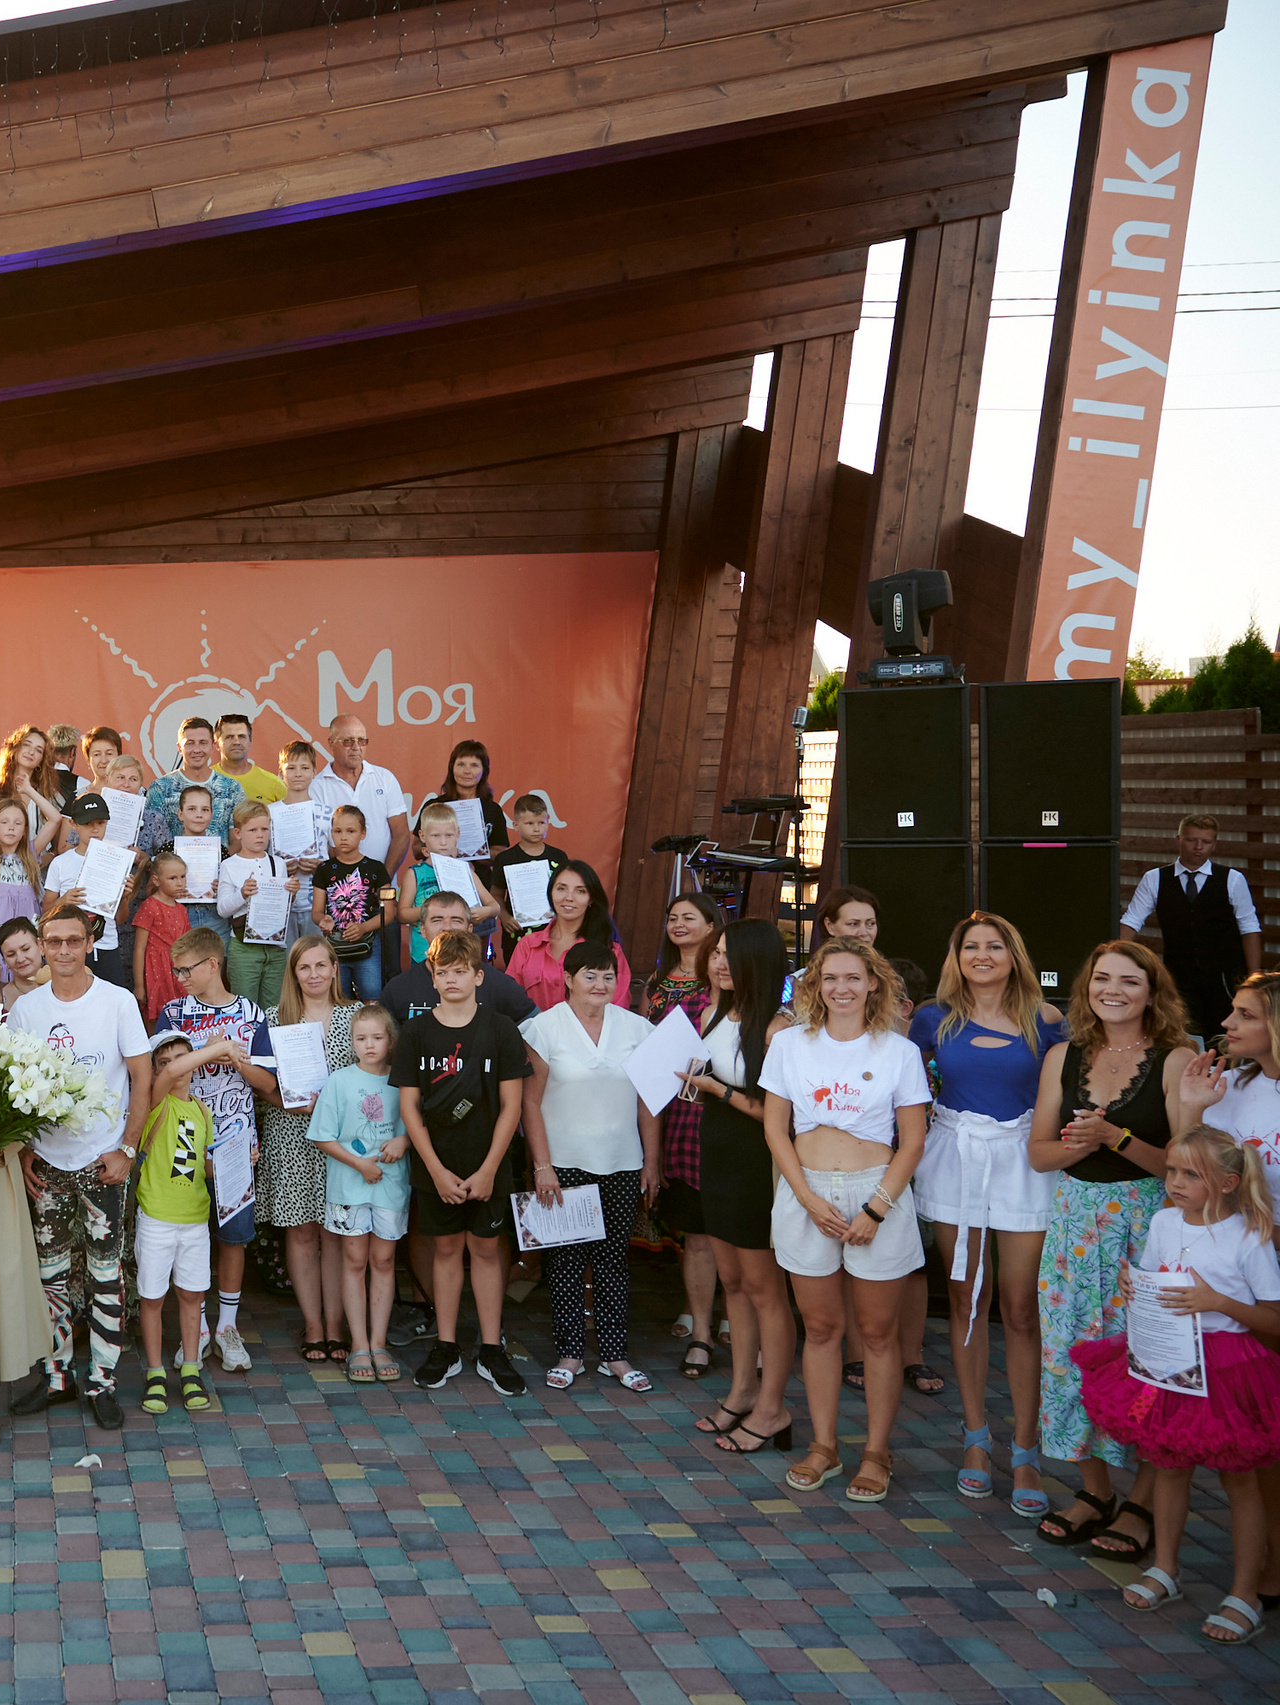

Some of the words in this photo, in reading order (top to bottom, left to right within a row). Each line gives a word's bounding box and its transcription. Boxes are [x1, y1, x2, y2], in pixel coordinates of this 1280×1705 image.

[1054, 66, 1191, 681] my_ilyinka
[317, 648, 476, 727] Моя
[84, 802, 98, 810] FILA
[899, 814, 912, 822] HK
[1043, 813, 1057, 821] HK
[1043, 973, 1056, 982] HK
[181, 1013, 242, 1035] Gulliver
[193, 1027, 226, 1041] SPOR
[419, 1056, 491, 1073] JORDN
[834, 1082, 861, 1096] Моя
